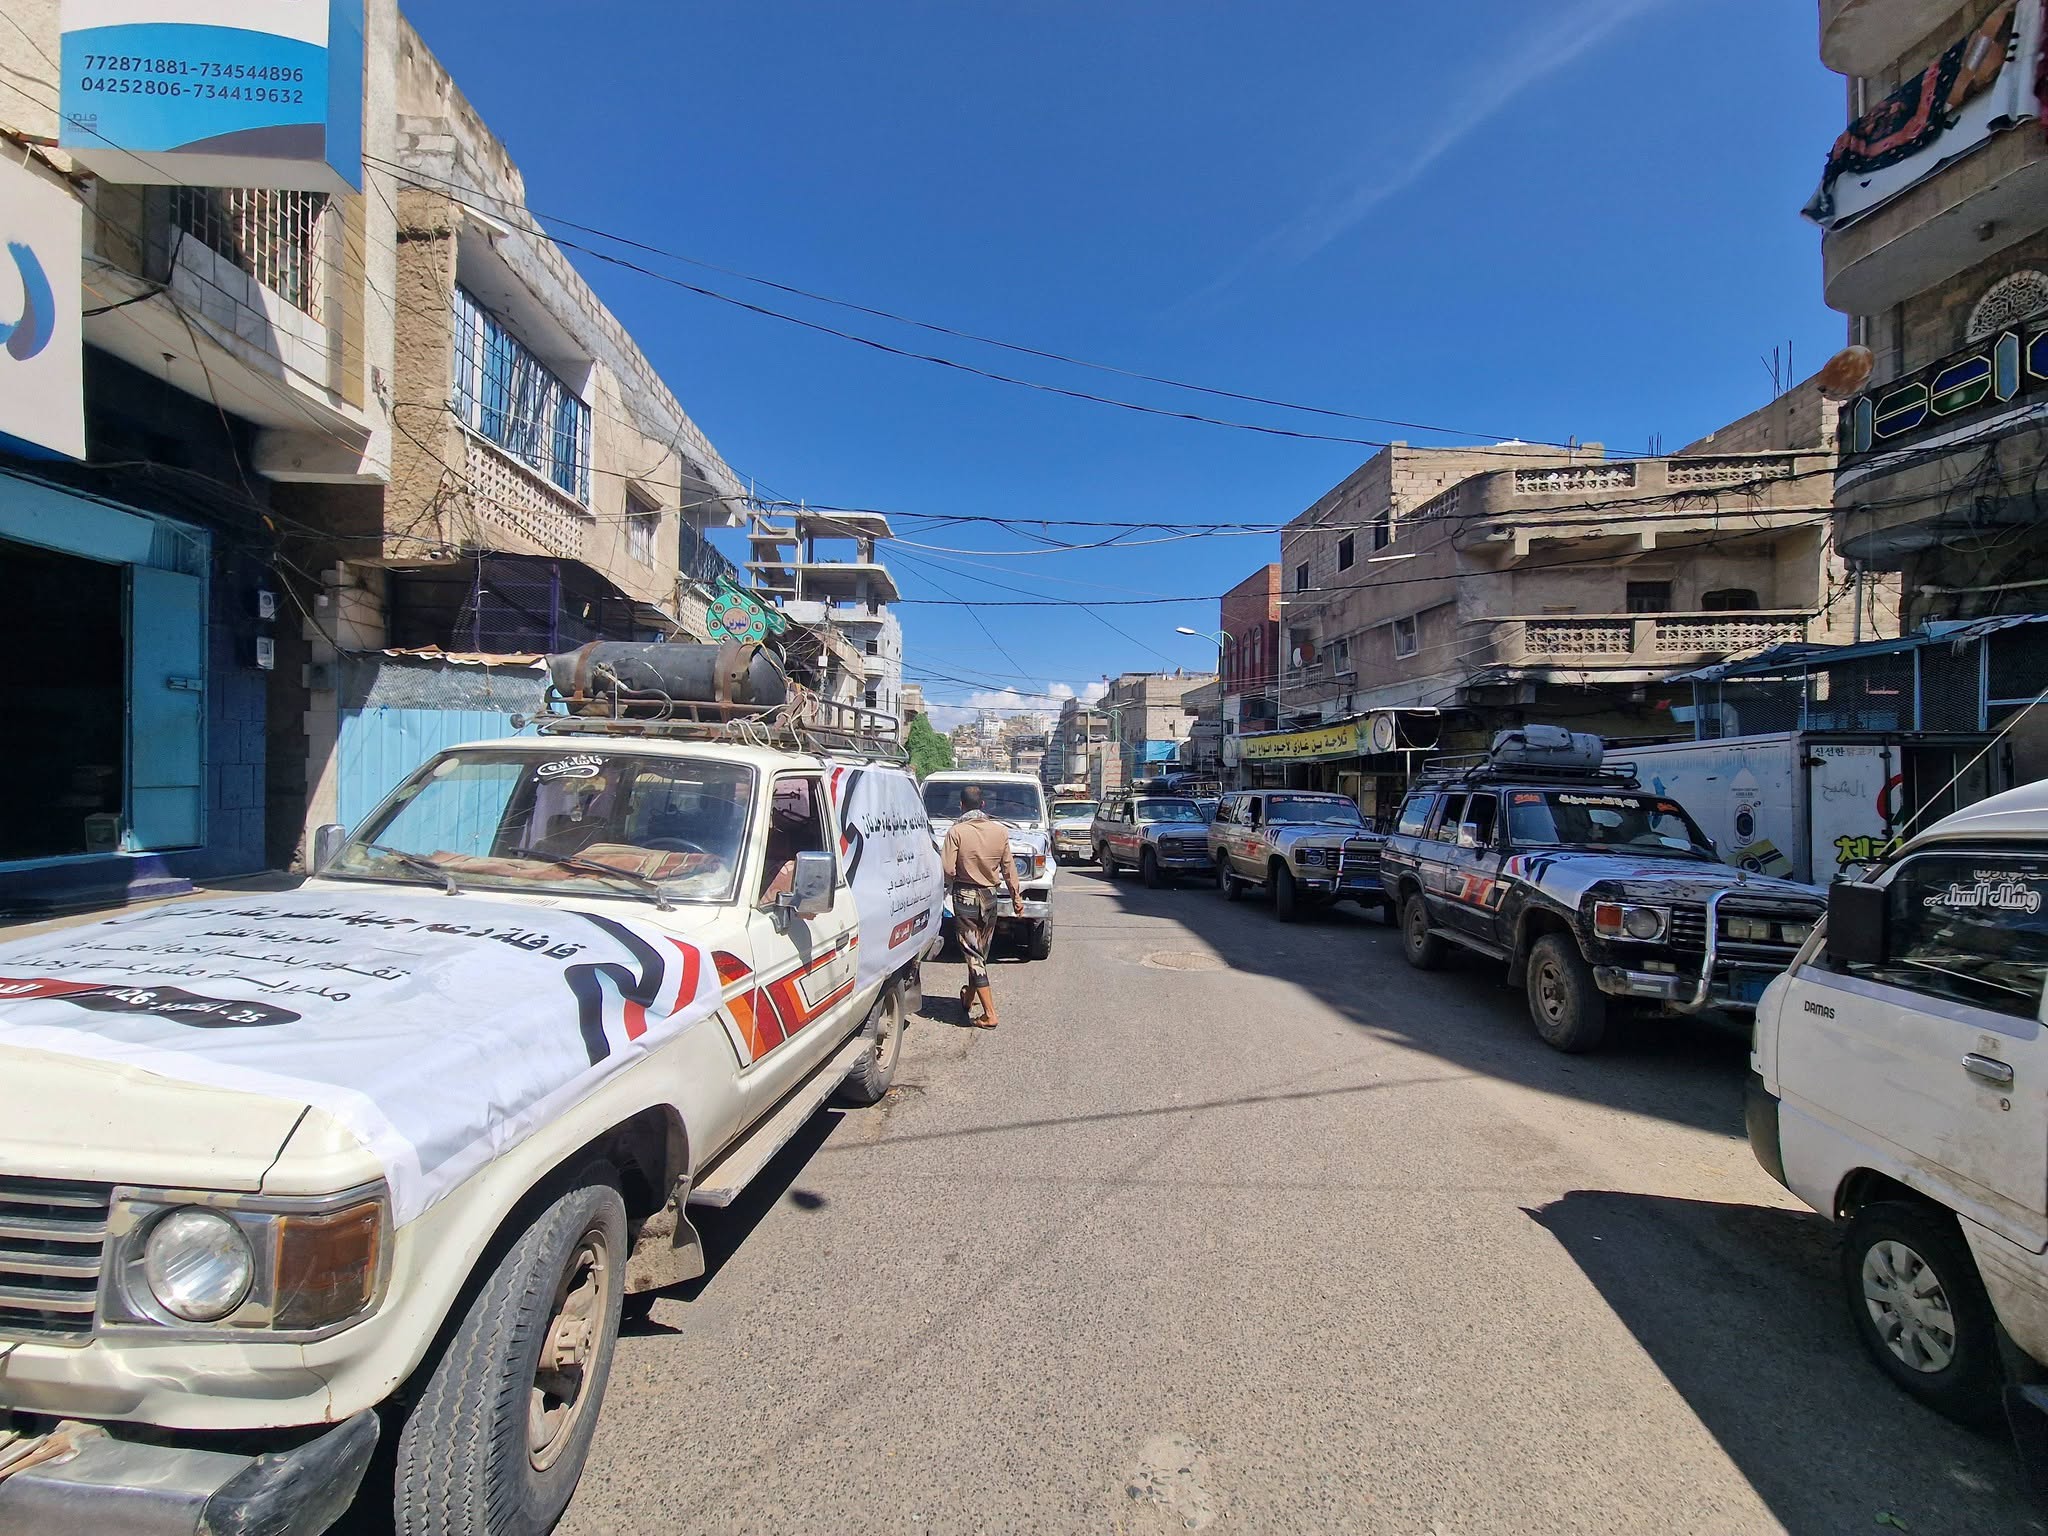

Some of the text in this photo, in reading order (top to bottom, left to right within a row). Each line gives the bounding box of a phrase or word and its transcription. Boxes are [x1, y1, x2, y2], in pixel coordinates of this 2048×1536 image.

[84, 55, 304, 82] 772871881-734544896
[81, 77, 304, 104] 04252806-734419632
[1324, 729, 1348, 750] ثلاجة
[1815, 747, 1845, 757] 신선한
[408, 923, 494, 938] دعم
[492, 927, 587, 960] قافلة
[226, 1010, 267, 1024] 25
[1804, 1000, 1835, 1019] DAMAS
